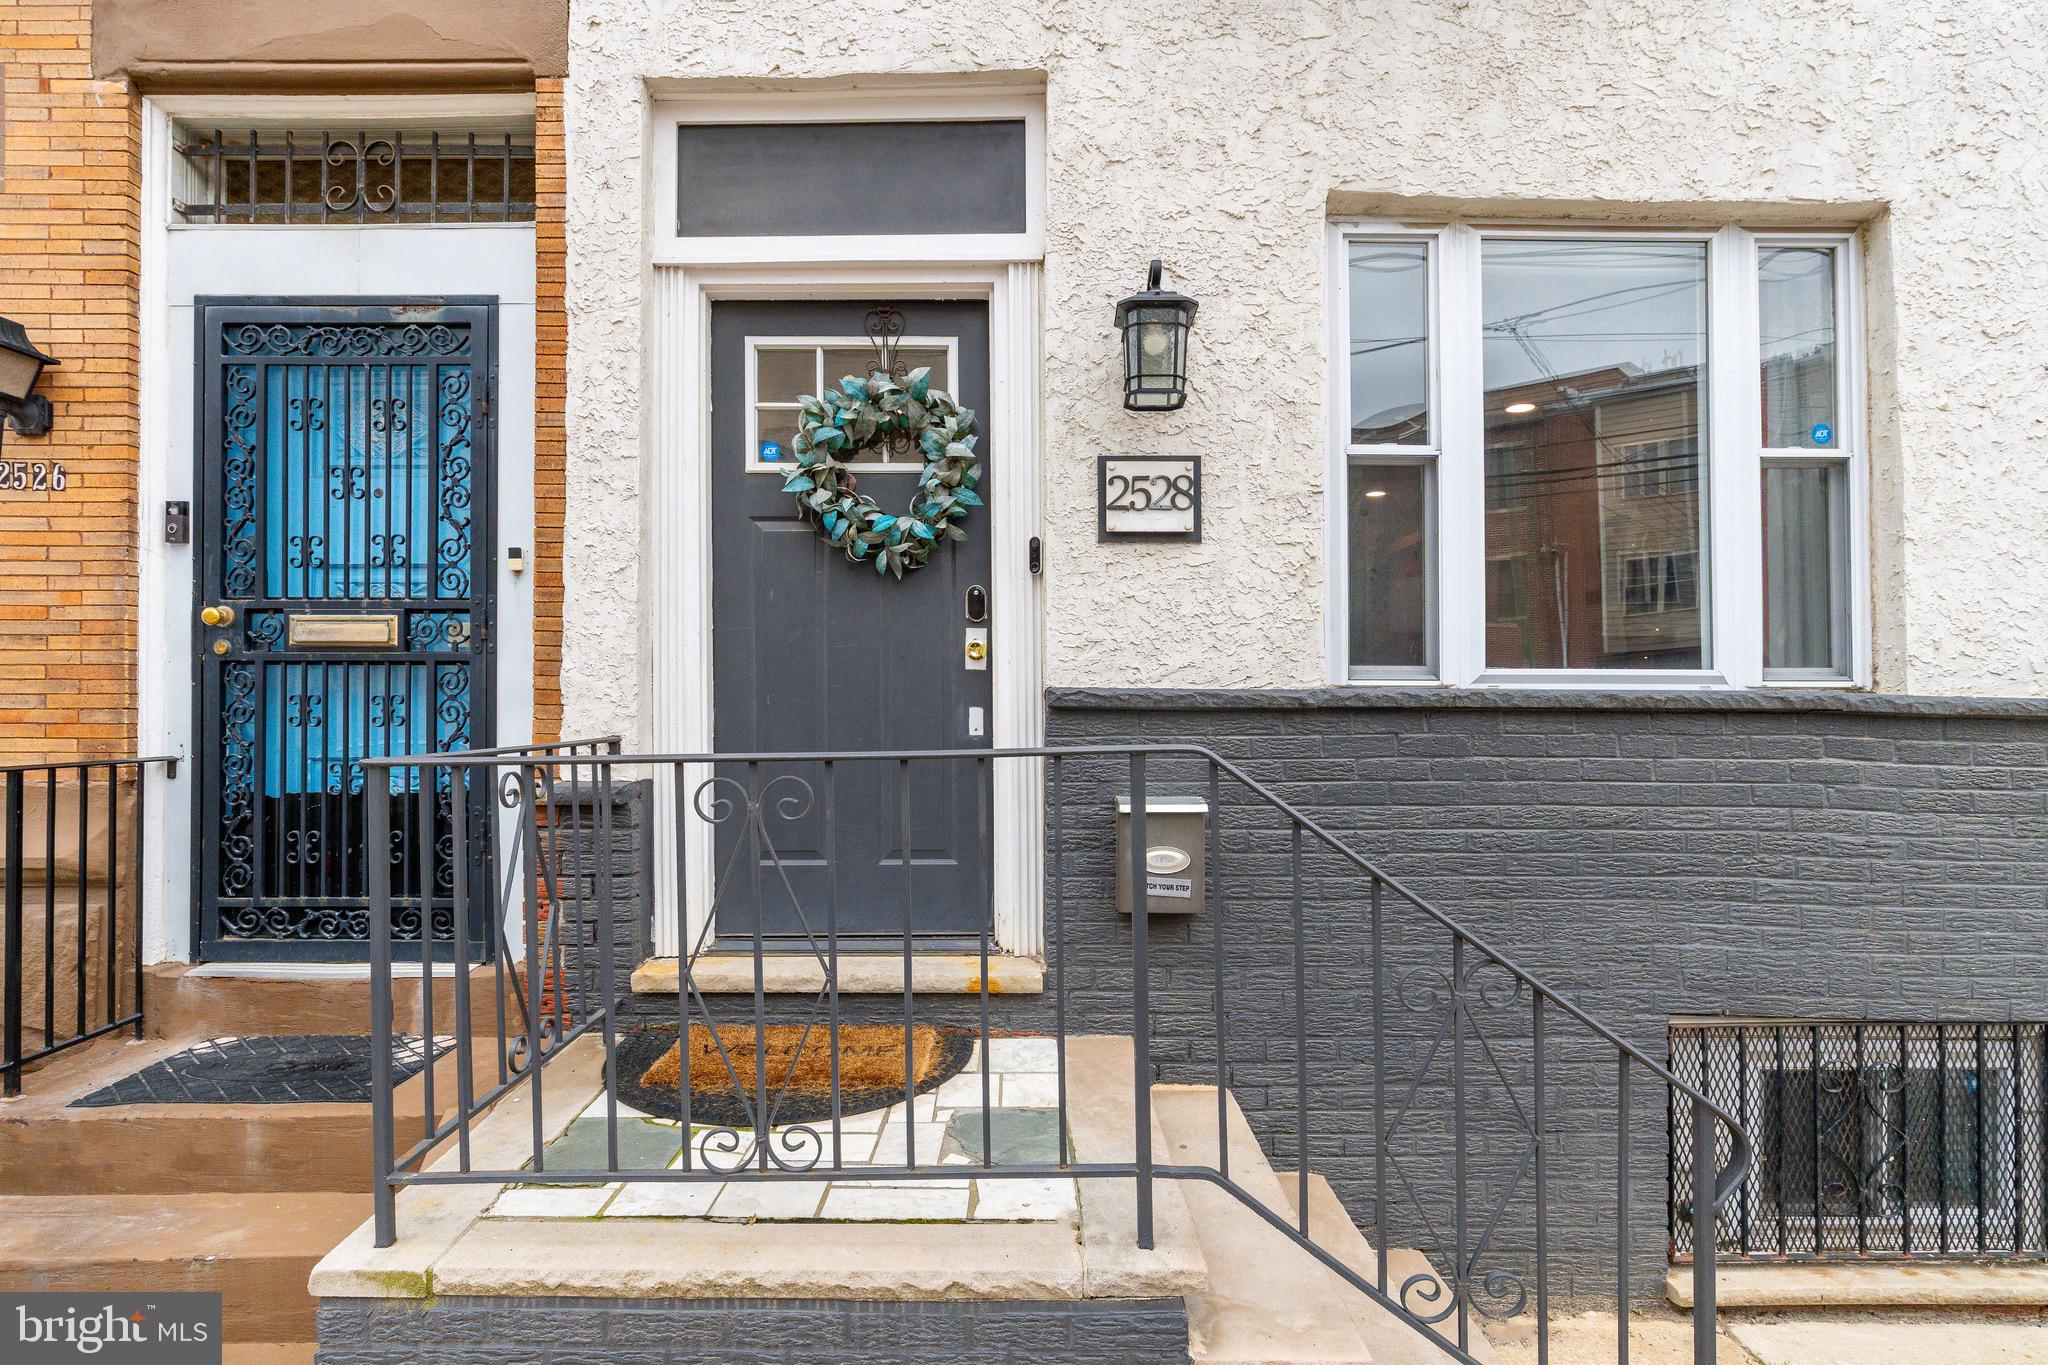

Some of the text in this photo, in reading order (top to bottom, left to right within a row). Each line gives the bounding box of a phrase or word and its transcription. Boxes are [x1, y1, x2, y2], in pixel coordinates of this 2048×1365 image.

[0, 462, 65, 490] 2526
[1106, 475, 1195, 511] 2528
[1159, 883, 1175, 891] YOUR
[1175, 884, 1190, 892] STEP
